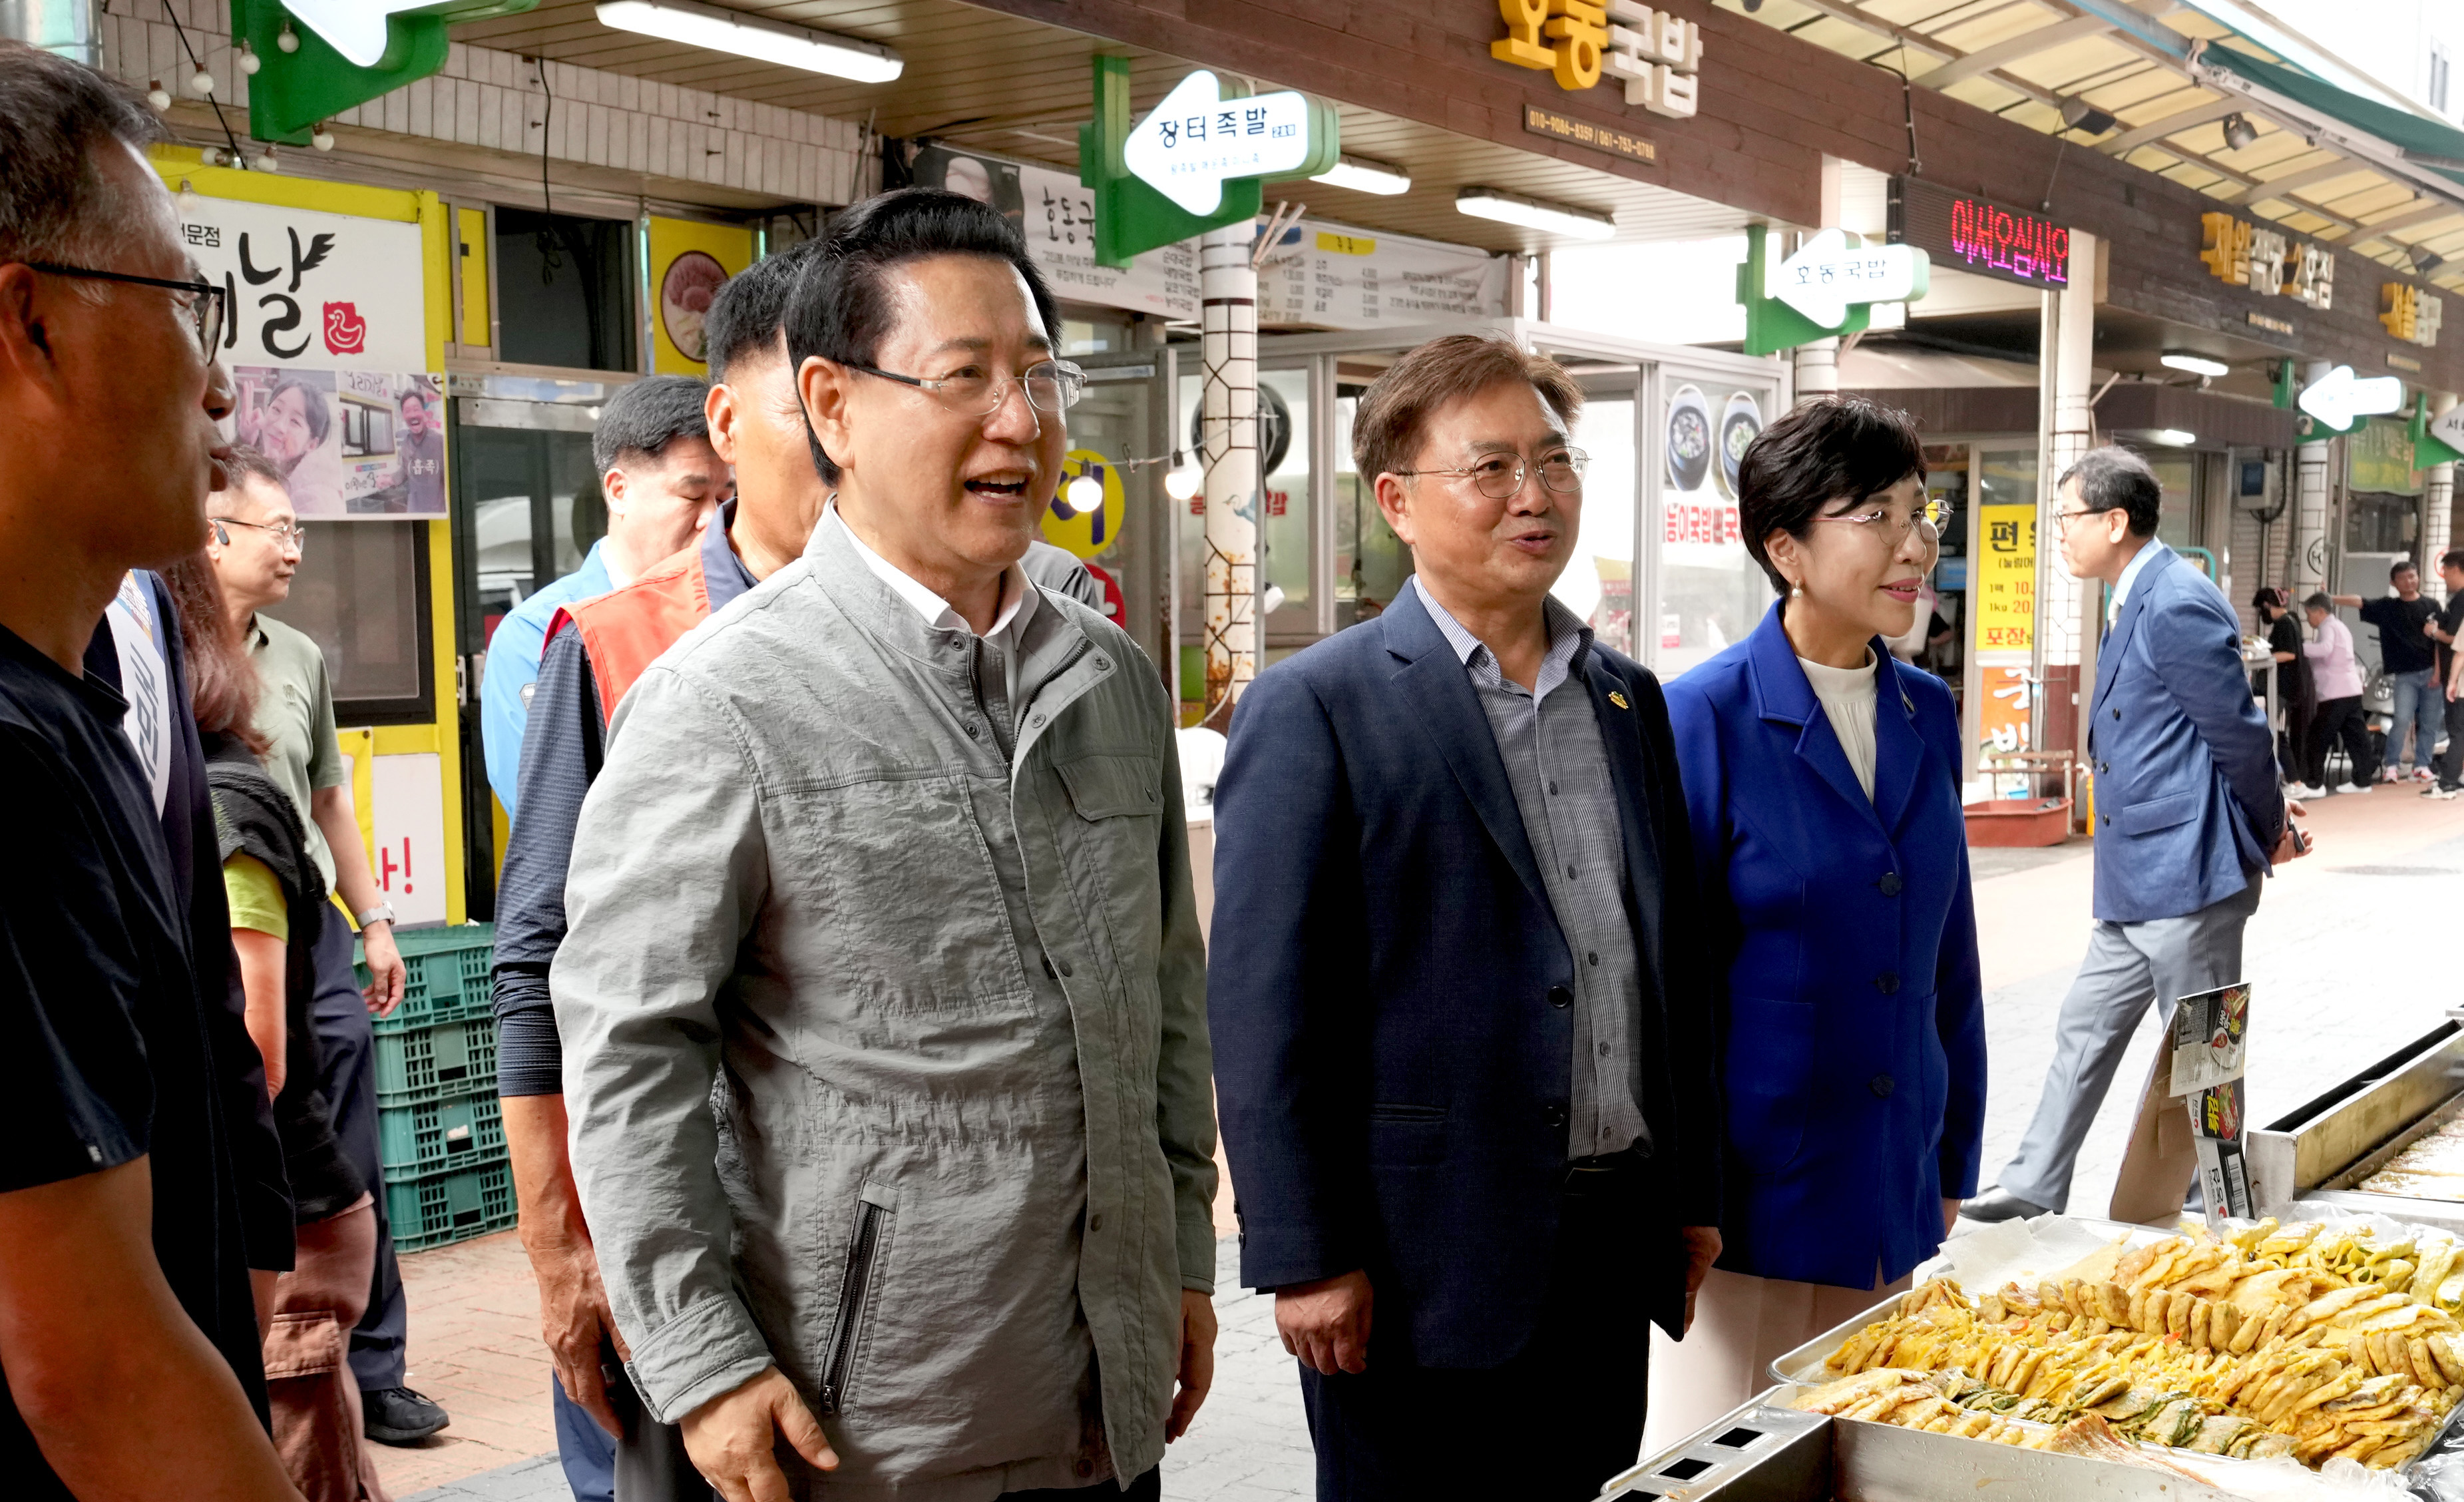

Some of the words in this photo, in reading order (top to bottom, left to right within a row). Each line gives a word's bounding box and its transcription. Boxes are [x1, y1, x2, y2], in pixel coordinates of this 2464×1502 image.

[1159, 107, 1267, 148] 장터족발
[180, 222, 220, 248] 문점
[1951, 199, 2068, 282] 어서오십시오
[1795, 259, 1887, 284] 호동국밥
[2446, 417, 2464, 430] 서
[1990, 521, 2018, 552] 편
[1989, 603, 2007, 612] 1kg
[130, 640, 159, 792] 국민
[2211, 1167, 2224, 1204] 농심
